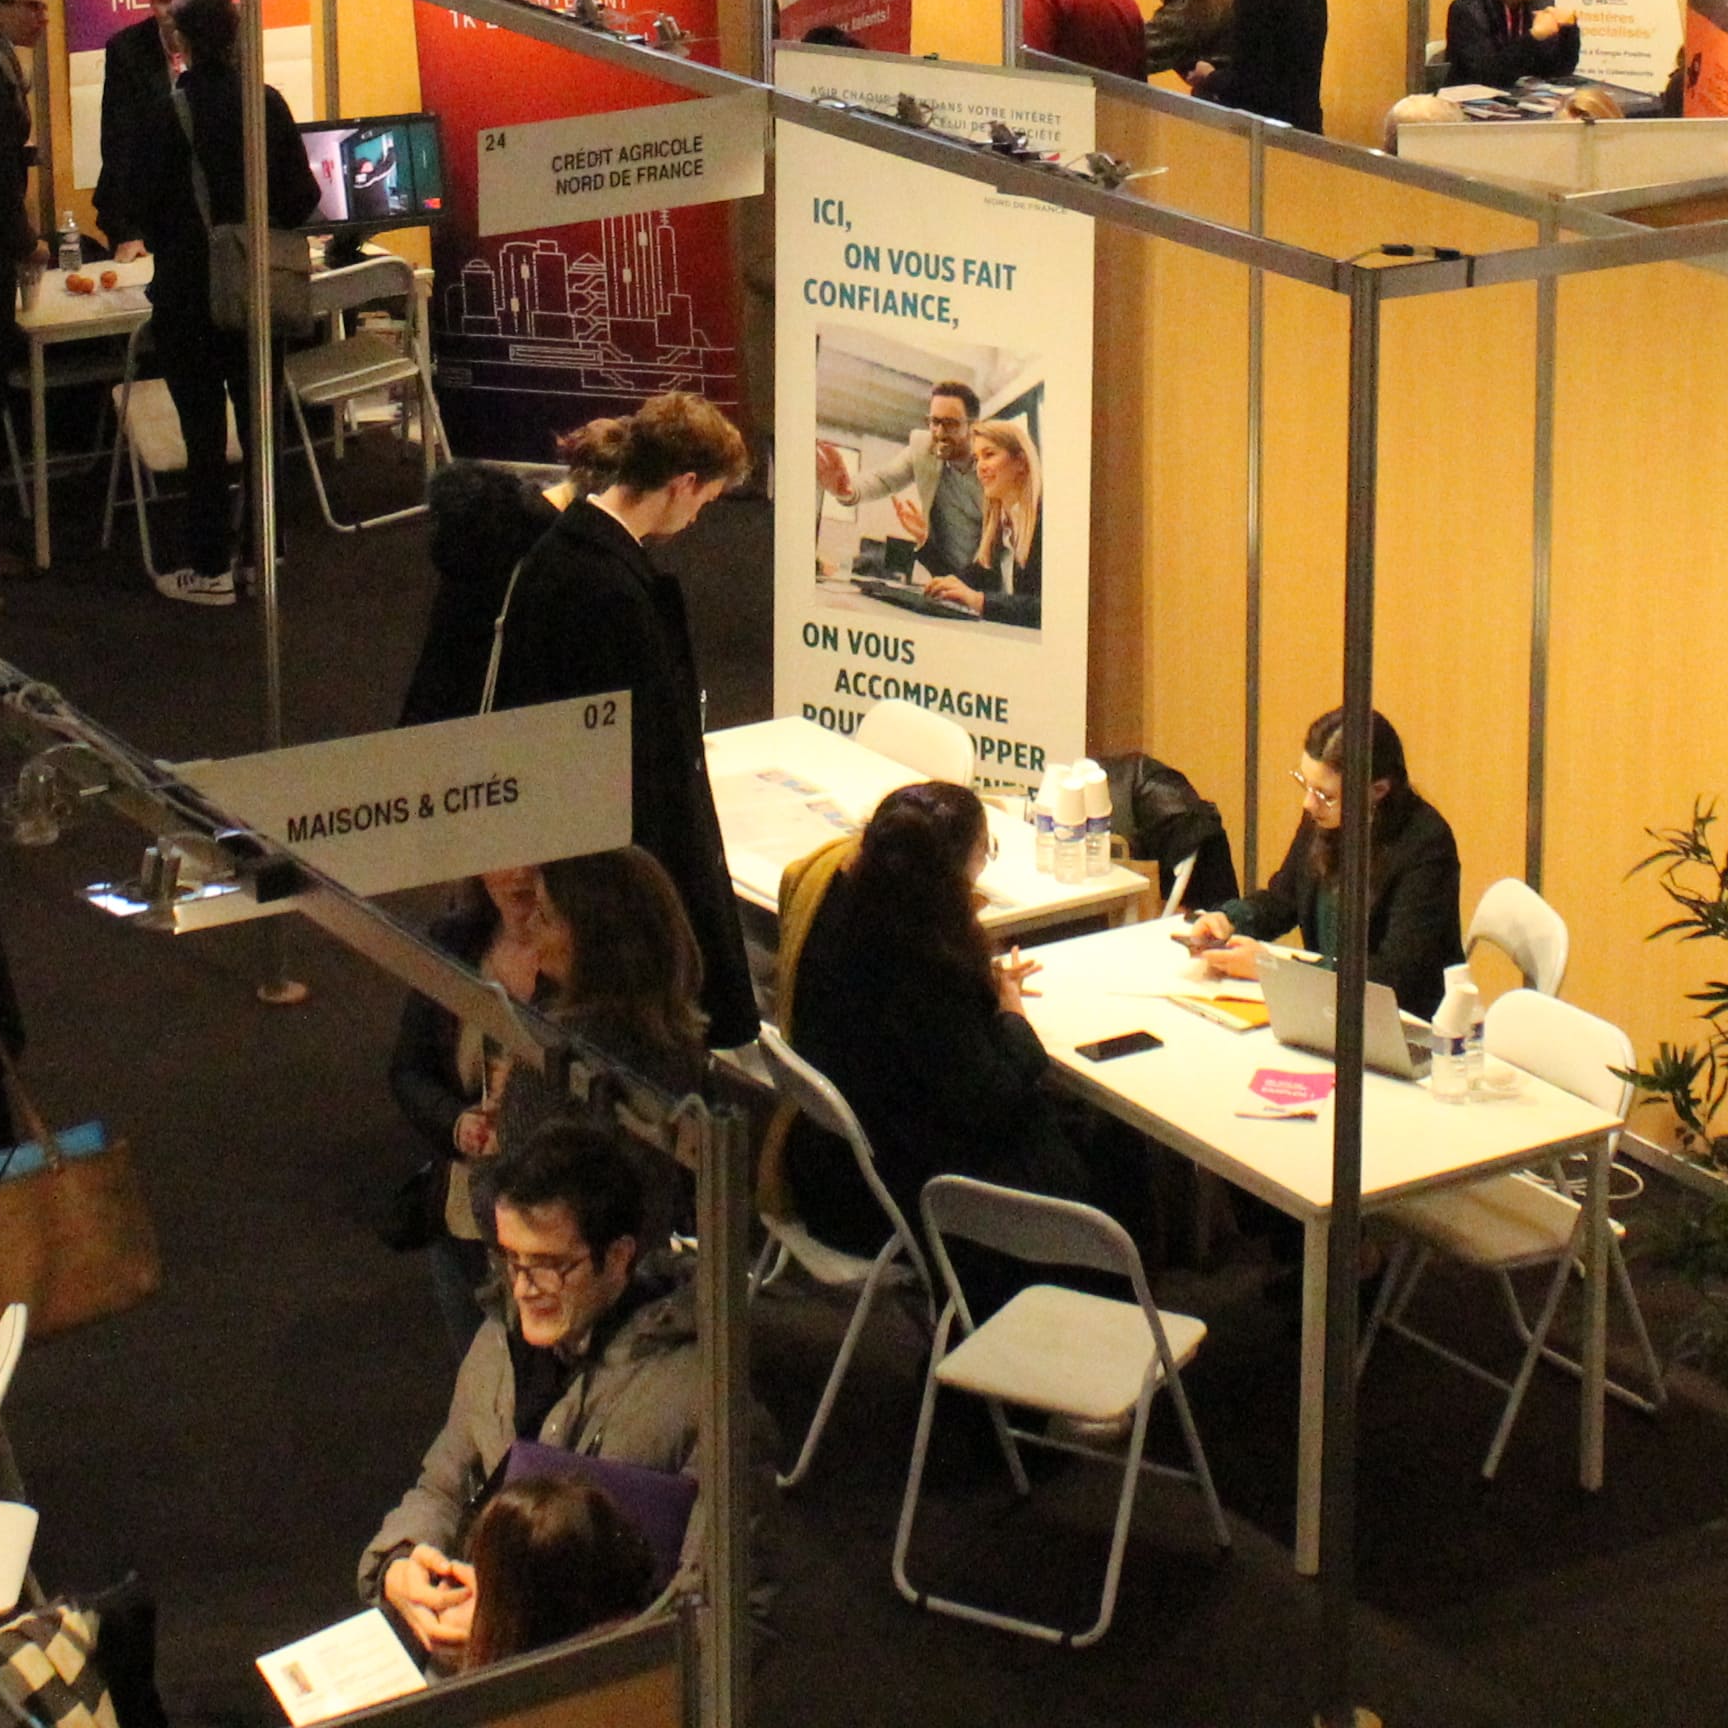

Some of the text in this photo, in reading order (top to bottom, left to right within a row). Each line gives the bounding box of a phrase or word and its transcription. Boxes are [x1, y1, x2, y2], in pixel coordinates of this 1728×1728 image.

[1578, 10, 1635, 24] astères
[810, 85, 839, 98] AGIR
[967, 104, 1007, 120] VOTRE
[484, 132, 507, 152] 24
[551, 134, 705, 174] CRÉDIT AGRICOLE
[556, 158, 705, 196] NORD DE FRANCE
[813, 197, 852, 232] ICI,
[844, 242, 1017, 292] ON VOUS FAIT
[803, 278, 960, 330] CONFIANCE,
[802, 621, 916, 666] ON VOUS
[583, 699, 617, 730] 02
[834, 668, 1009, 724] ACCOMPAGNE
[286, 772, 520, 844] MAISONS & CITÉS
